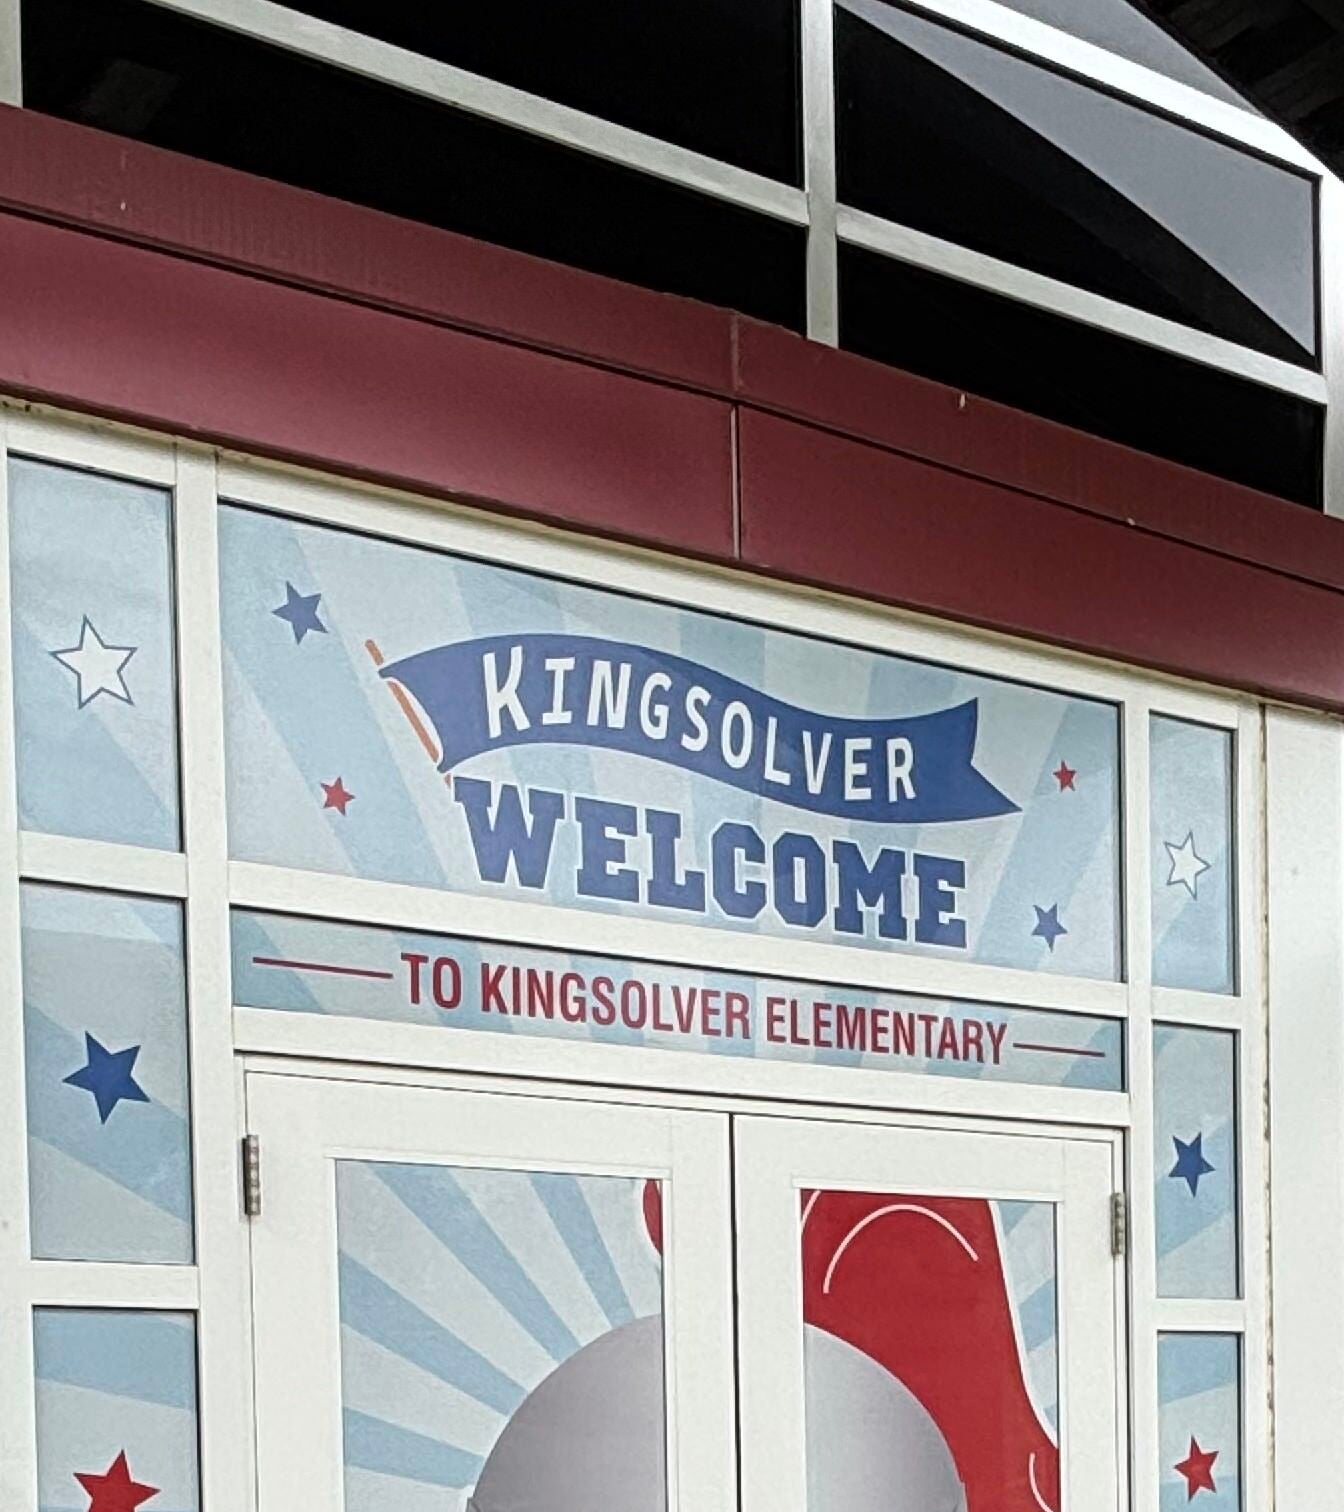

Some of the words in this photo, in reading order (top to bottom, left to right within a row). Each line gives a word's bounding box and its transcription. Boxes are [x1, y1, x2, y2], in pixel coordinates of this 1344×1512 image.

[482, 645, 917, 803] KINGSOLVER
[453, 776, 968, 950] WELCOME
[400, 952, 462, 1009] TO
[481, 963, 751, 1040] KINGSOLVER
[766, 997, 1008, 1066] ELEMENTARY
